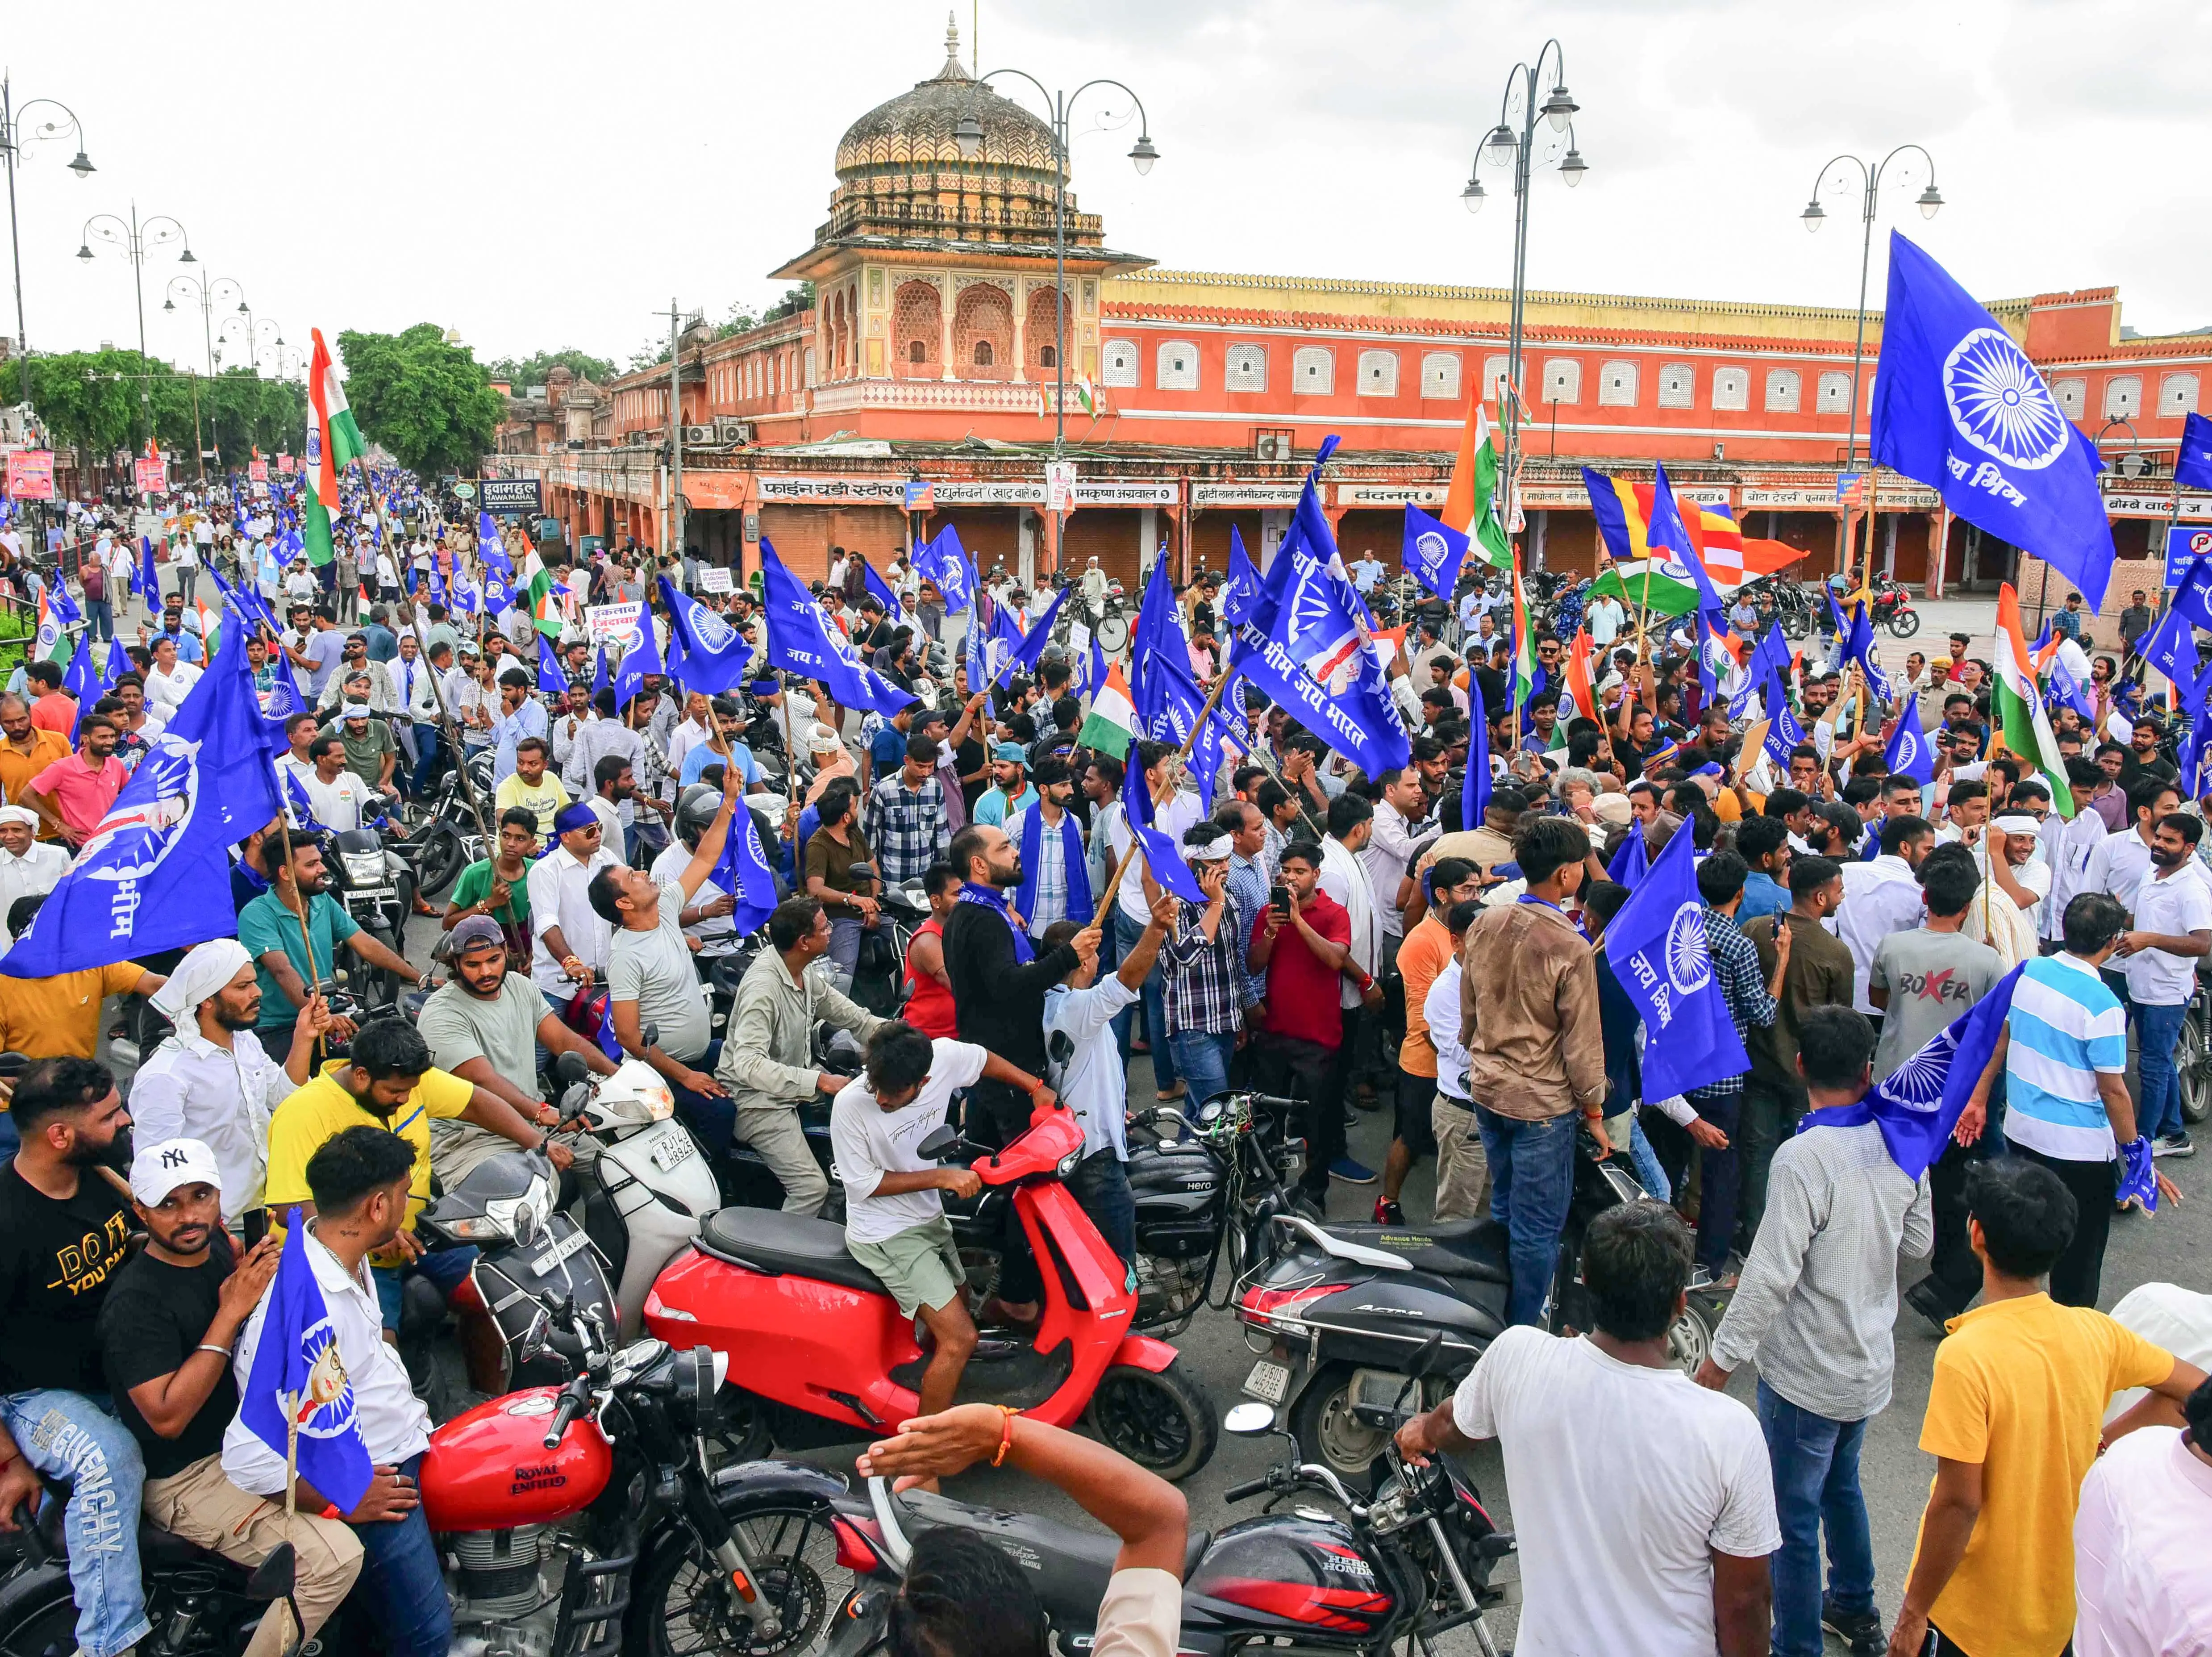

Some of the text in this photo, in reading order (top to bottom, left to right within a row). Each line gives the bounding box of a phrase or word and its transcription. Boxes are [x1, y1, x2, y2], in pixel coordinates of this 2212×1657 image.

[1947, 448, 2027, 507] जय भिम
[483, 483, 536, 495] हवामहल
[764, 481, 812, 496] फाईन
[853, 482, 894, 497] स्टोर
[1075, 489, 1115, 501] ामकृष्ण
[1116, 488, 1158, 500] अग्रवाल
[1219, 490, 1234, 499] लाल
[1354, 489, 1421, 502] वंदनम्
[1527, 491, 1562, 501] माधोलाल
[2109, 498, 2141, 509] बोम्बे
[1421, 562, 1431, 577] जय
[2193, 582, 2206, 594] जय
[791, 600, 809, 614] ज
[787, 647, 812, 664] जय
[1263, 641, 1296, 681] भीम
[1295, 676, 1328, 713] जय
[1327, 702, 1369, 751] भारत
[1220, 706, 1249, 739] जय भिम
[1766, 733, 1791, 762] जय भि
[110, 880, 141, 939] भीम
[1630, 950, 1672, 1029] जय भिम
[1900, 967, 1970, 1005] BOXER
[888, 1105, 943, 1144] Tommy Hilfiger
[649, 1131, 668, 1144] HONDA
[662, 1128, 687, 1153] RJ14J
[161, 1148, 189, 1169] NY
[667, 1140, 694, 1165] H8945
[1187, 1182, 1212, 1190] Hero
[56, 1232, 100, 1281] DO
[67, 1264, 106, 1296] YOU
[1259, 1363, 1284, 1382] RJ60S
[1252, 1378, 1279, 1397] H5295
[515, 1464, 558, 1481] ROYAL
[51, 1423, 123, 1553] GIVENCHY
[510, 1475, 567, 1495] ENFIELD
[1323, 1562, 1375, 1576] HONDA
[1329, 1555, 1369, 1569] HERO
